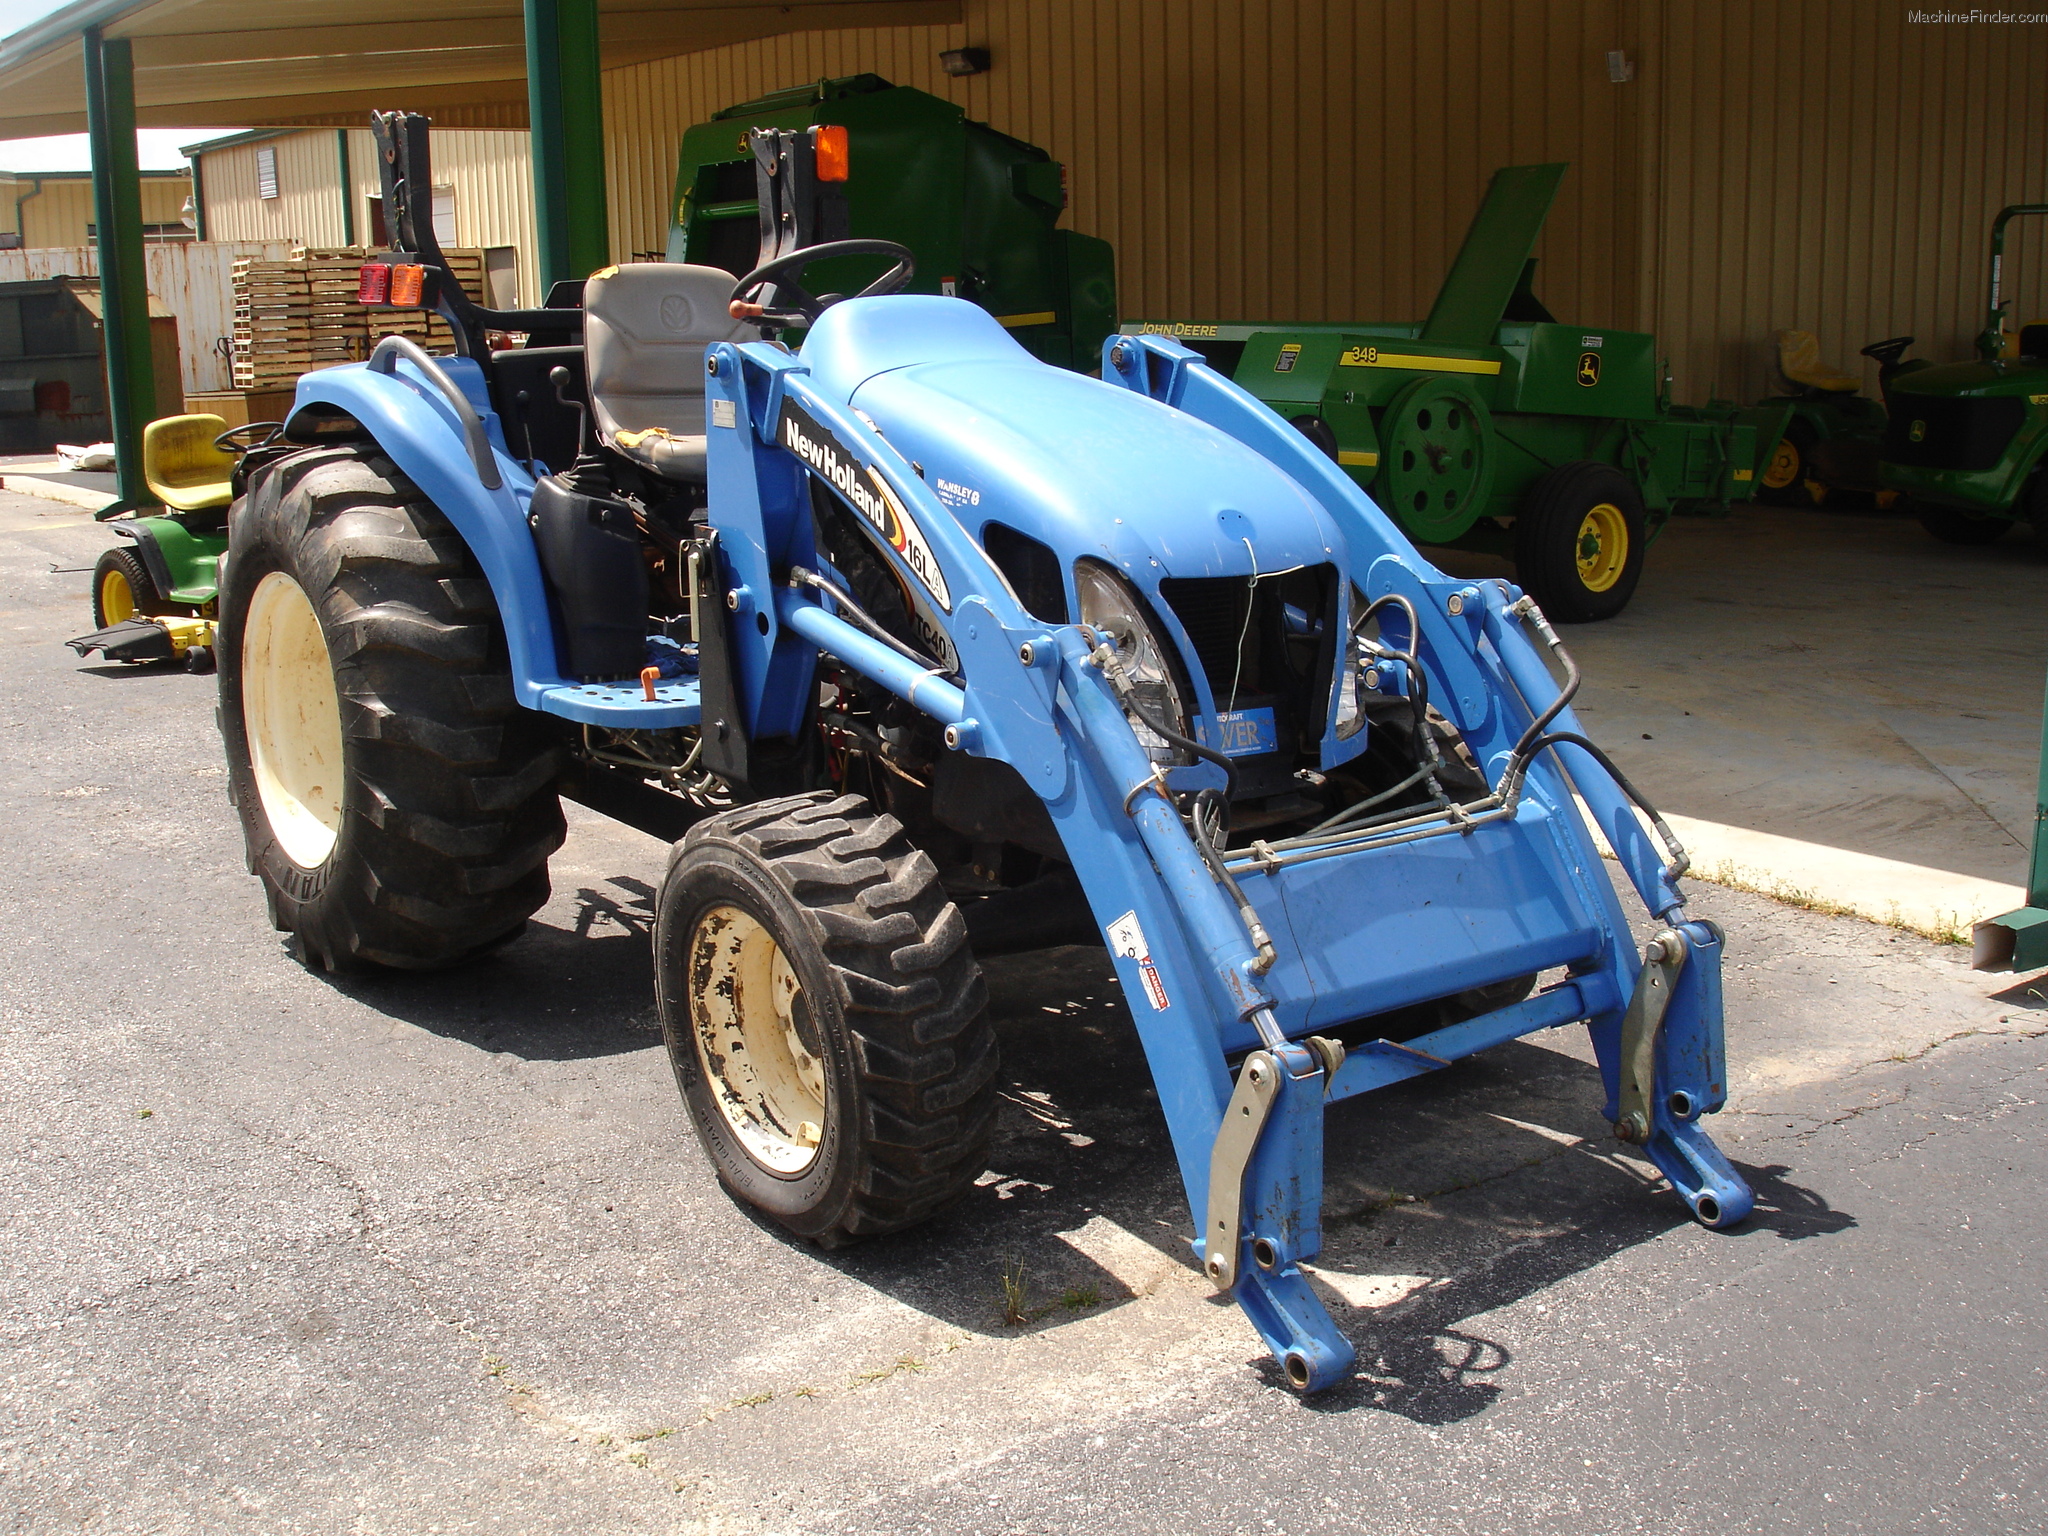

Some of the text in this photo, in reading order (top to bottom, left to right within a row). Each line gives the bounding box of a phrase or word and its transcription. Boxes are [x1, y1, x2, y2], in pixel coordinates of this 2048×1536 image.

[1138, 322, 1218, 337] JOHN DEERE
[1352, 346, 1378, 363] 348
[908, 538, 943, 600] 16LA
[1148, 968, 1166, 1004] DANGER
